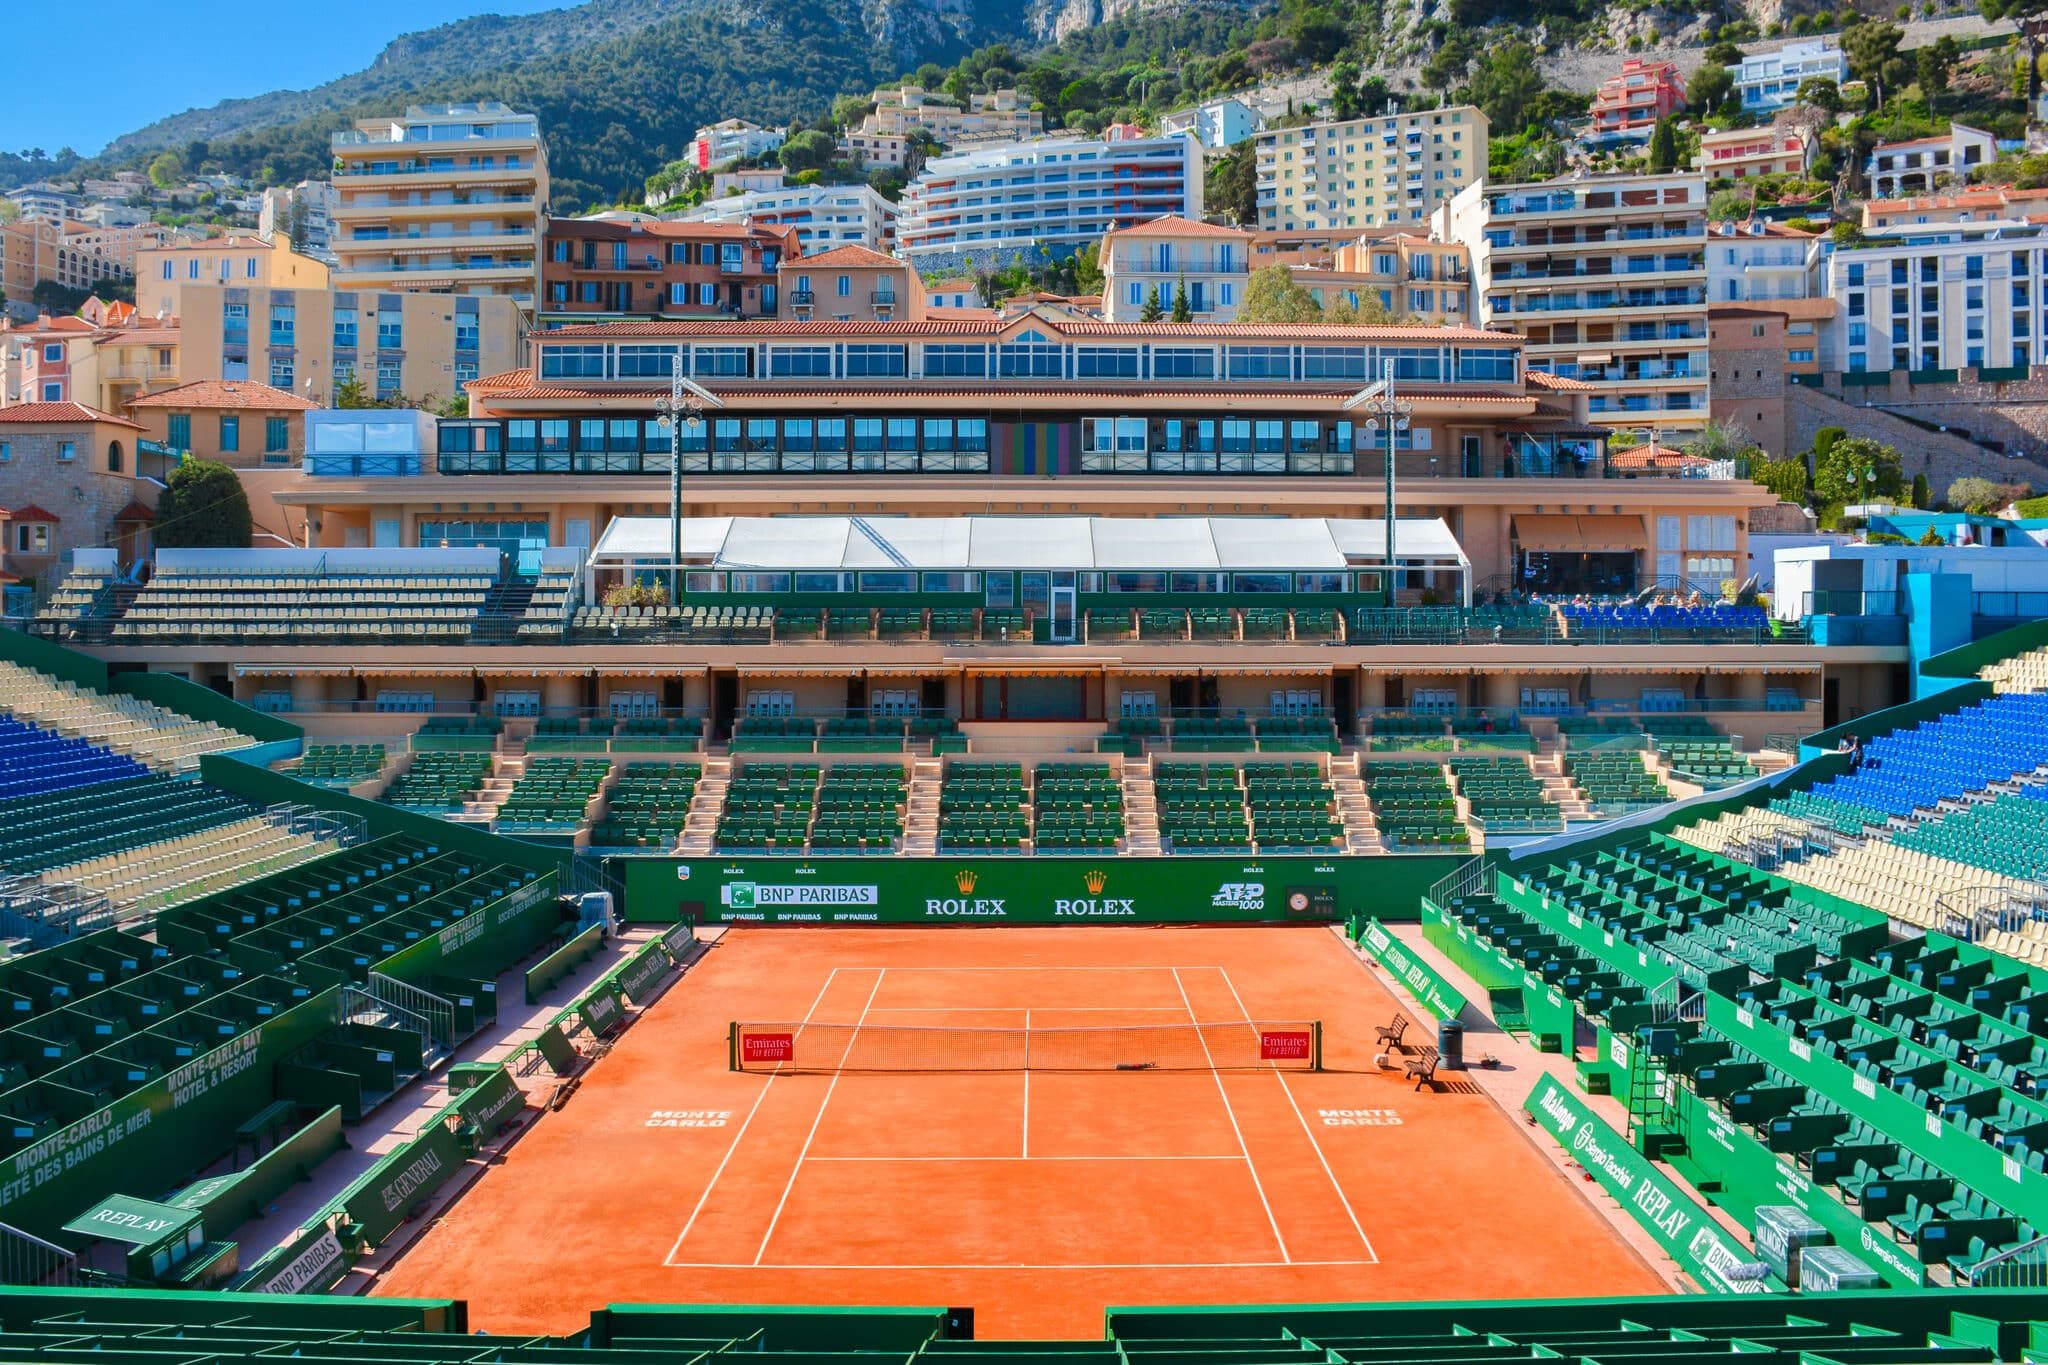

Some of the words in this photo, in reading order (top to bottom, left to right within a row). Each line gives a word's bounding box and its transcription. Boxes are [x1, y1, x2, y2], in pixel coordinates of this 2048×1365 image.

[760, 888, 794, 902] BNP
[799, 888, 870, 902] PARIBAS
[1211, 883, 1265, 901] ATP
[925, 899, 1006, 915] ROLEX
[1055, 899, 1136, 915] ROLEX
[1239, 900, 1264, 910] 1000
[1405, 965, 1431, 993] REPLAY
[745, 1038, 790, 1049] Emirates
[1263, 1036, 1307, 1047] Emirates
[168, 1040, 241, 1092] MONTE-CARLO
[243, 1028, 262, 1051] BAY
[174, 1076, 208, 1109] HOTEL
[211, 1070, 218, 1087] &
[221, 1047, 258, 1082] RESORT
[479, 1084, 520, 1122] Maserati
[651, 1110, 733, 1118] MONTE
[1317, 1109, 1398, 1117] MONTE
[645, 1119, 727, 1127] CARLO
[1323, 1118, 1404, 1126] CARLO
[16, 1109, 112, 1174] MONTE-CARLO
[34, 1157, 62, 1187] DES
[65, 1133, 105, 1170] BAINS
[107, 1123, 124, 1146] DE
[126, 1107, 151, 1135] MER
[394, 1148, 442, 1198] GENERALI
[1585, 1137, 1607, 1166] Sergio
[1603, 1153, 1634, 1190] Tacchini
[92, 1209, 175, 1232] REPLAY
[1632, 1177, 1692, 1240] REPLAY
[271, 1271, 295, 1295] BNP
[293, 1237, 337, 1282] PARIBAS
[1708, 1246, 1733, 1273] BNP
[1872, 1240, 1893, 1265] Sergio
[1892, 1254, 1920, 1285] Tacchini
